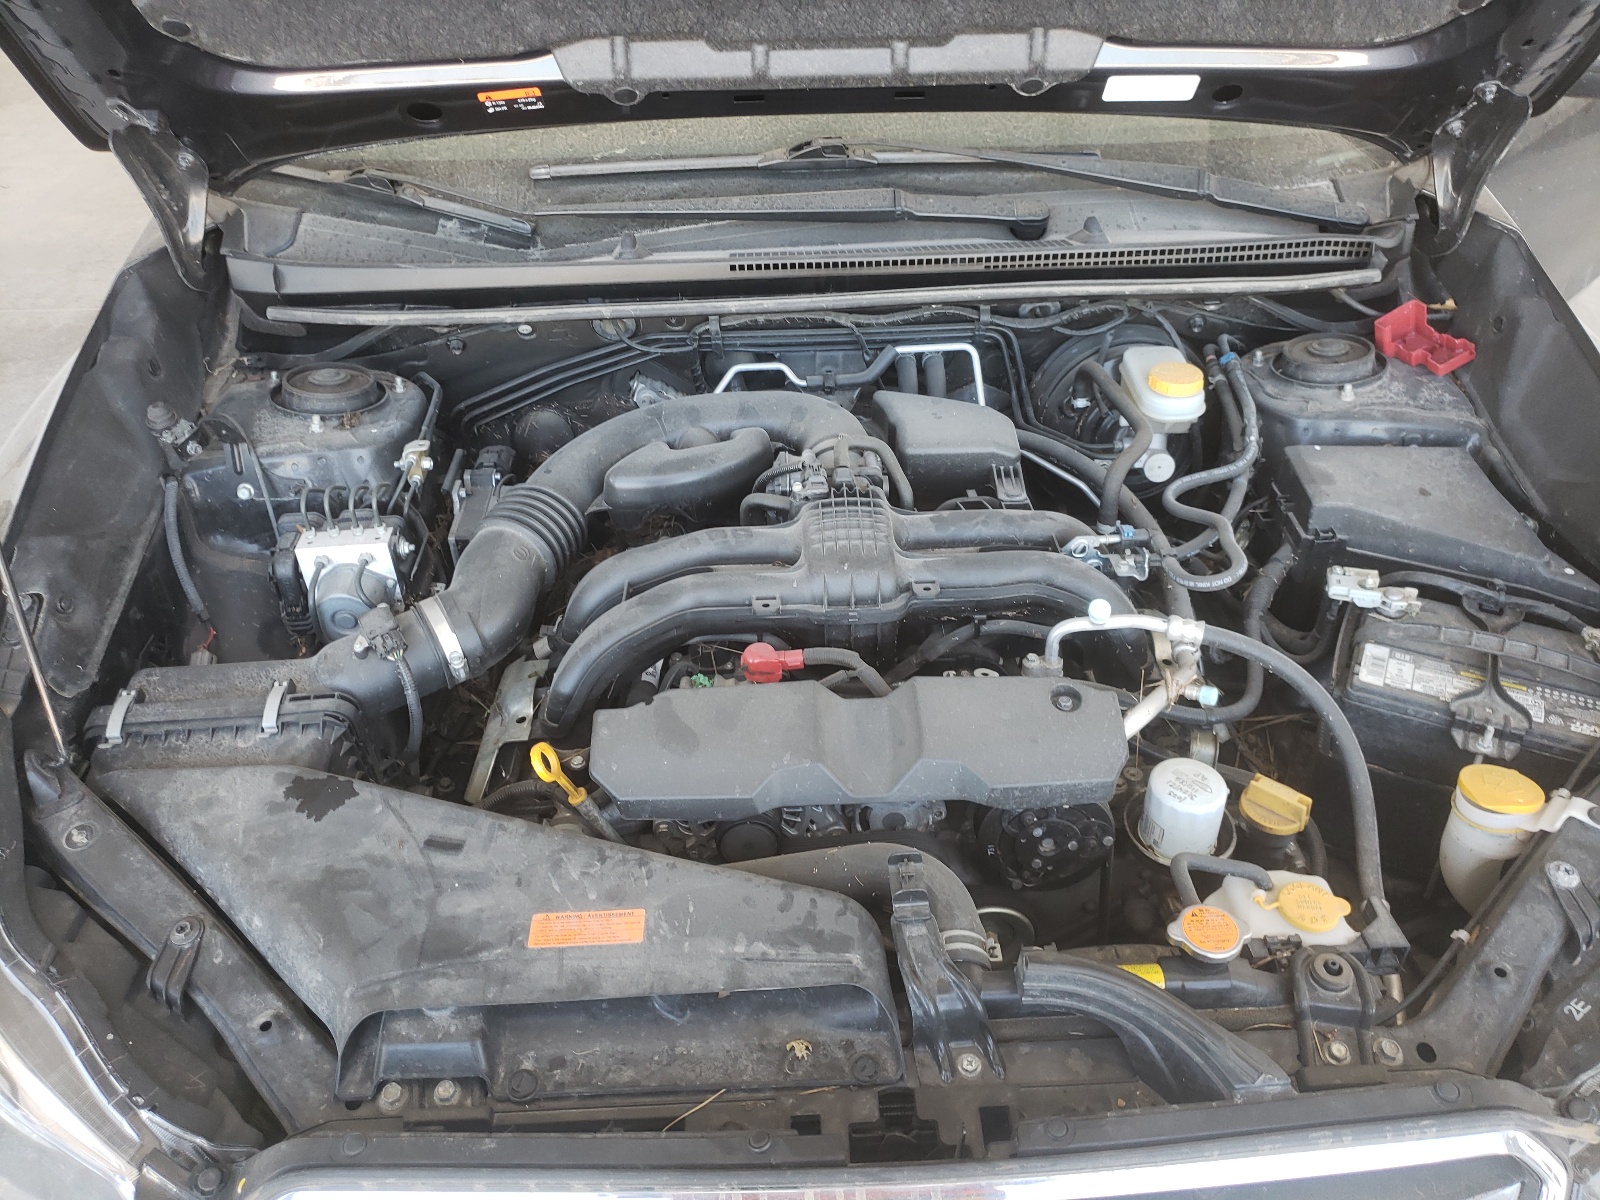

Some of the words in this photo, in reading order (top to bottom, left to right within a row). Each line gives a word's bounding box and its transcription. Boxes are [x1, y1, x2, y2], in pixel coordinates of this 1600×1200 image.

[1211, 579, 1223, 587] NOT
[1223, 576, 1232, 584] DO
[1563, 997, 1592, 1021] 2E
